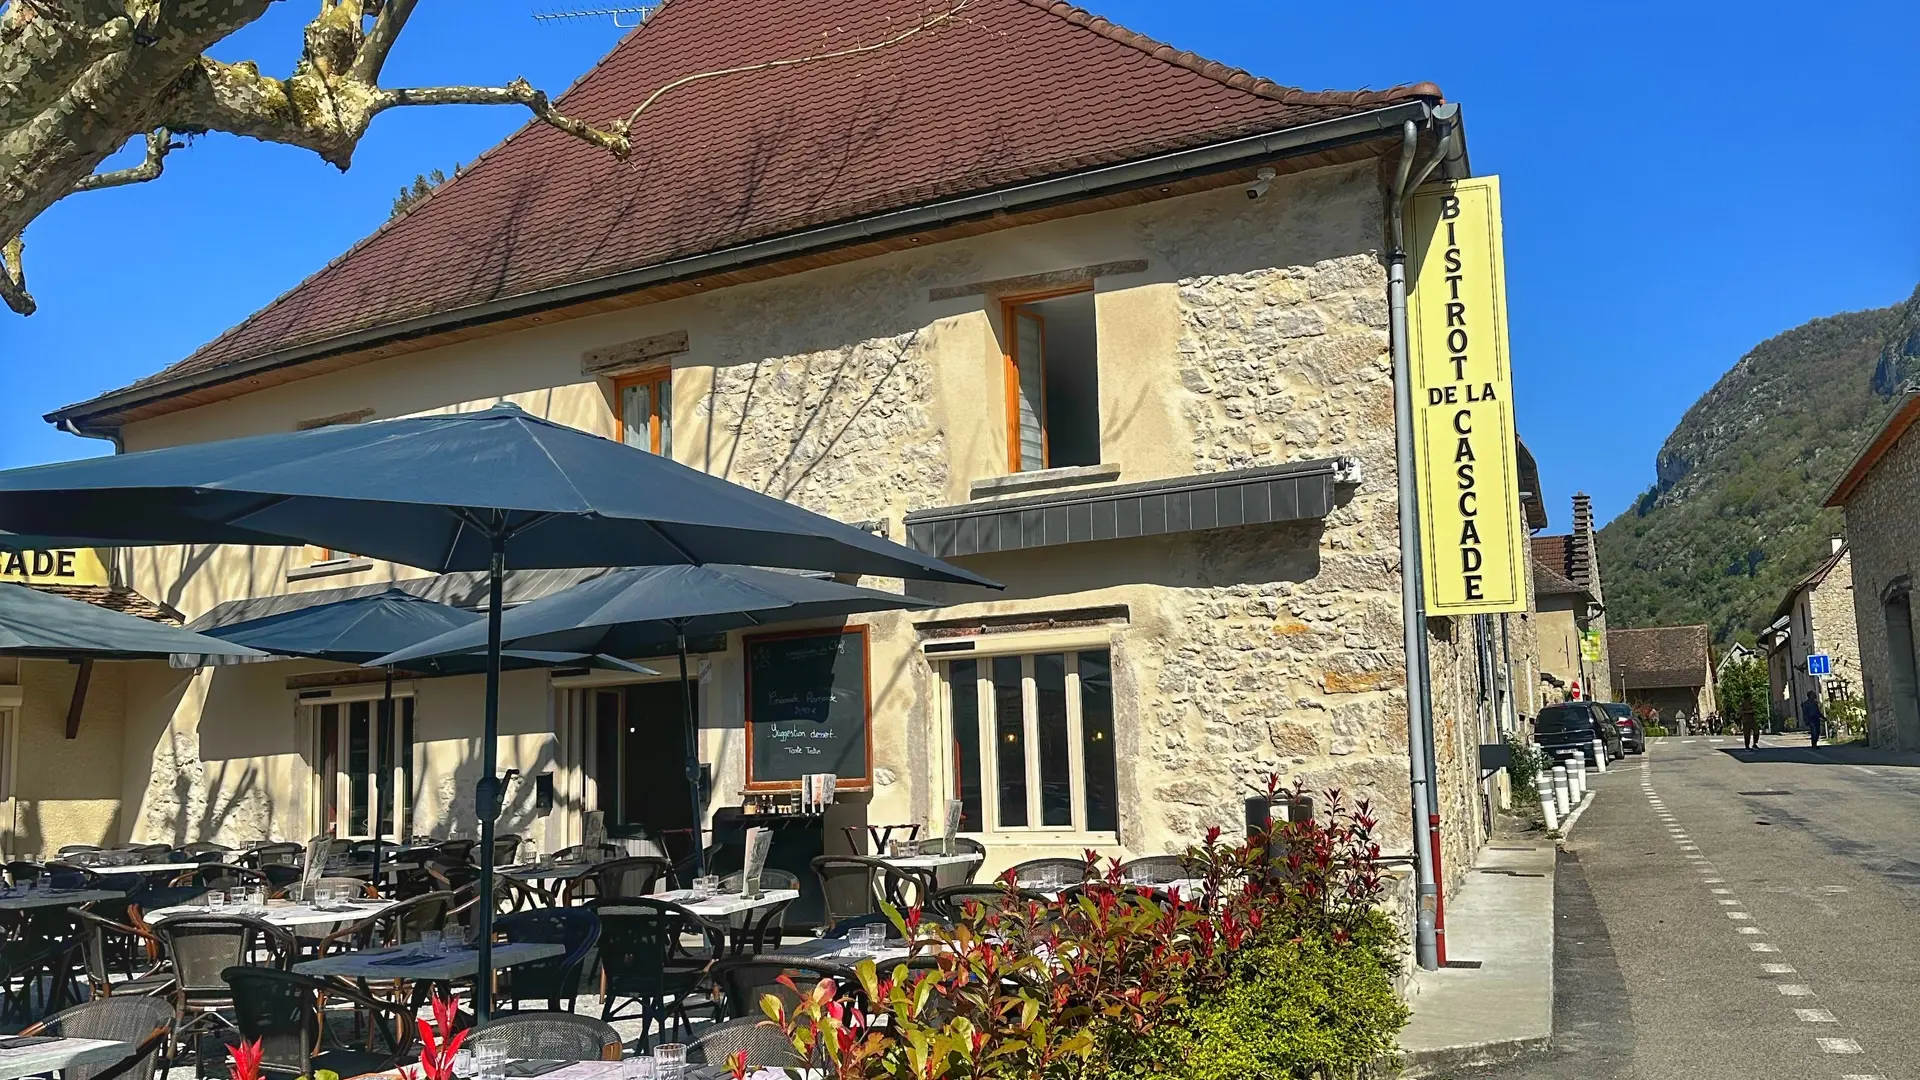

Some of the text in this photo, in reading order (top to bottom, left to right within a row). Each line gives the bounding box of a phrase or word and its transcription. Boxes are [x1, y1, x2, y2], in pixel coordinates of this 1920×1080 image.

[1439, 195, 1468, 381] BISTROT
[1427, 382, 1497, 406] DE LA
[1452, 409, 1484, 601] CASCADE
[0, 549, 76, 577] ADE
